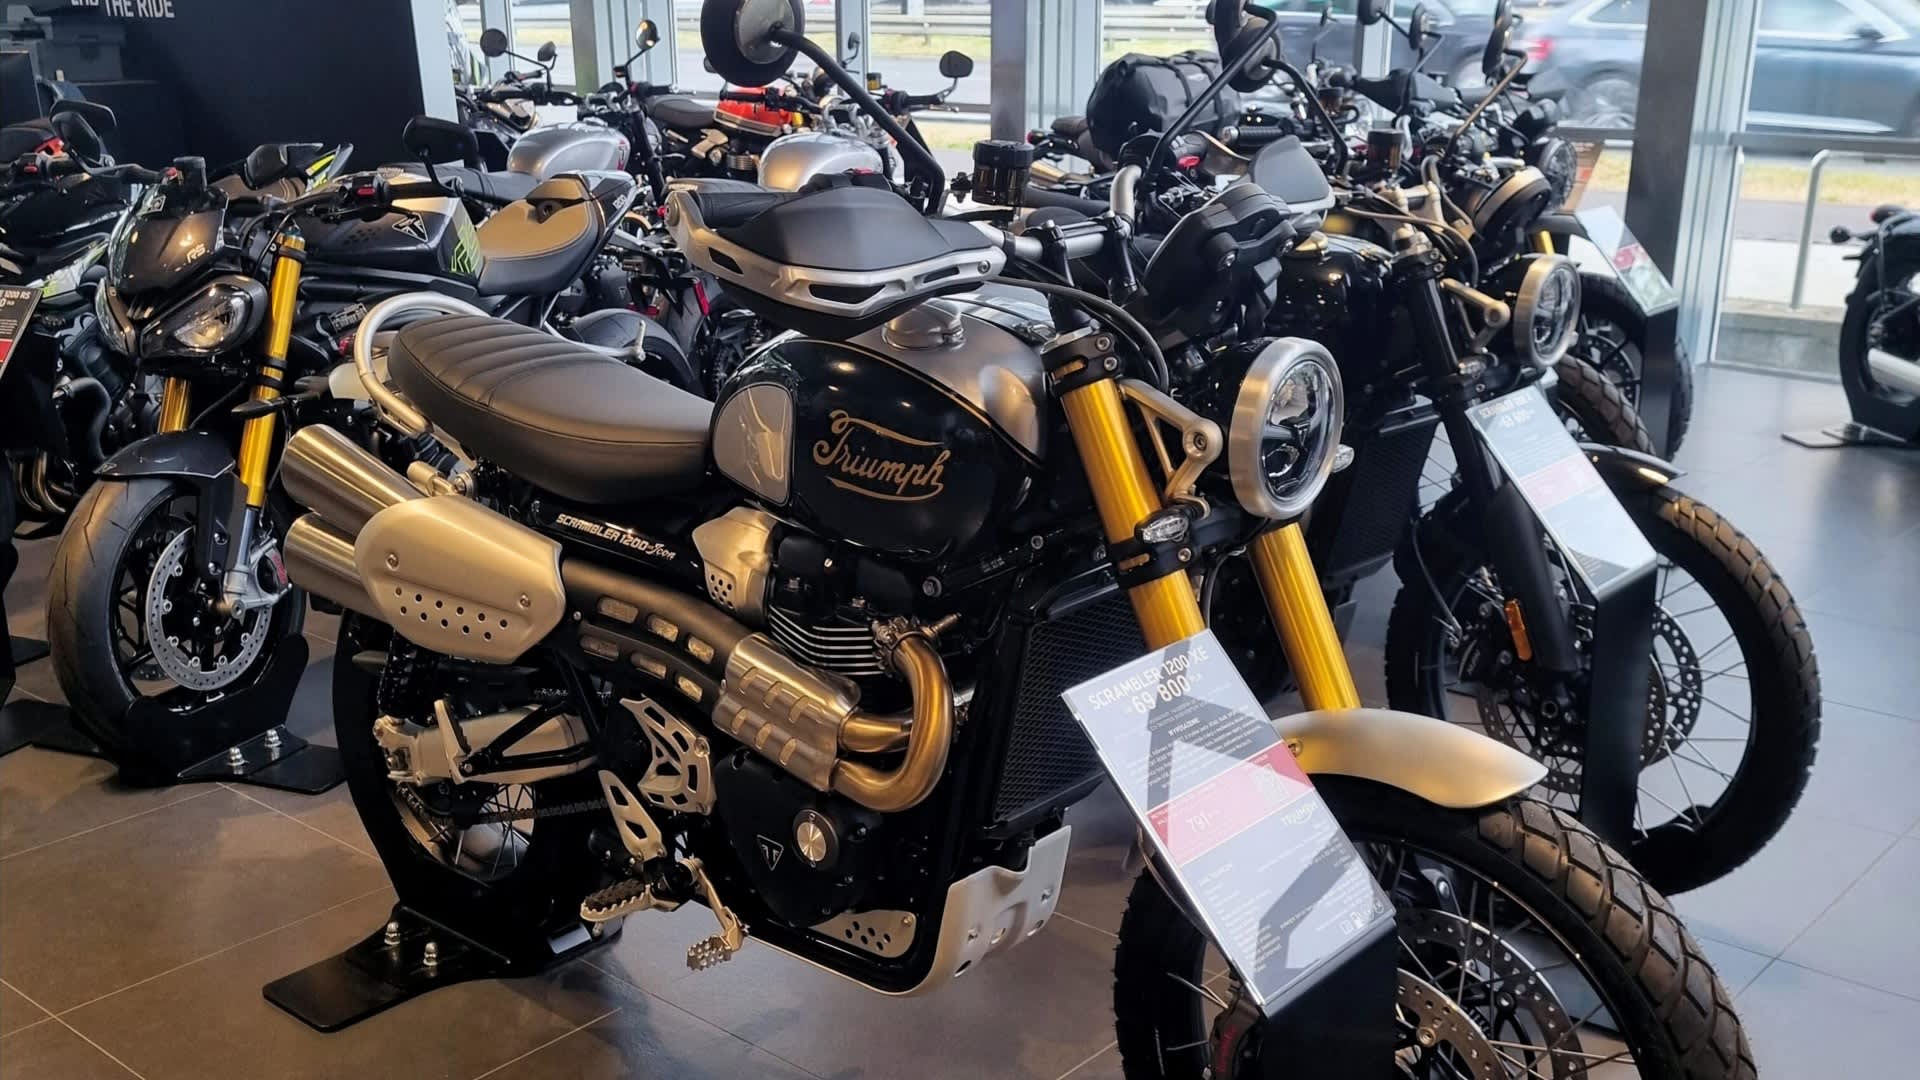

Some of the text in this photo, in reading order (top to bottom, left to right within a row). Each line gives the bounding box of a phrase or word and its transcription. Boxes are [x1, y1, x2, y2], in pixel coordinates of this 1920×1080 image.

[104, 0, 175, 18] THE RIDE
[187, 243, 206, 263] RS
[813, 409, 951, 501] Triumph
[556, 513, 621, 542] SCRAMBLER
[619, 534, 649, 552] 1200
[1088, 667, 1165, 711] SCRAMBLER
[1162, 654, 1190, 676] 1200
[1187, 646, 1210, 664] XE
[1131, 675, 1191, 714] 69 800
